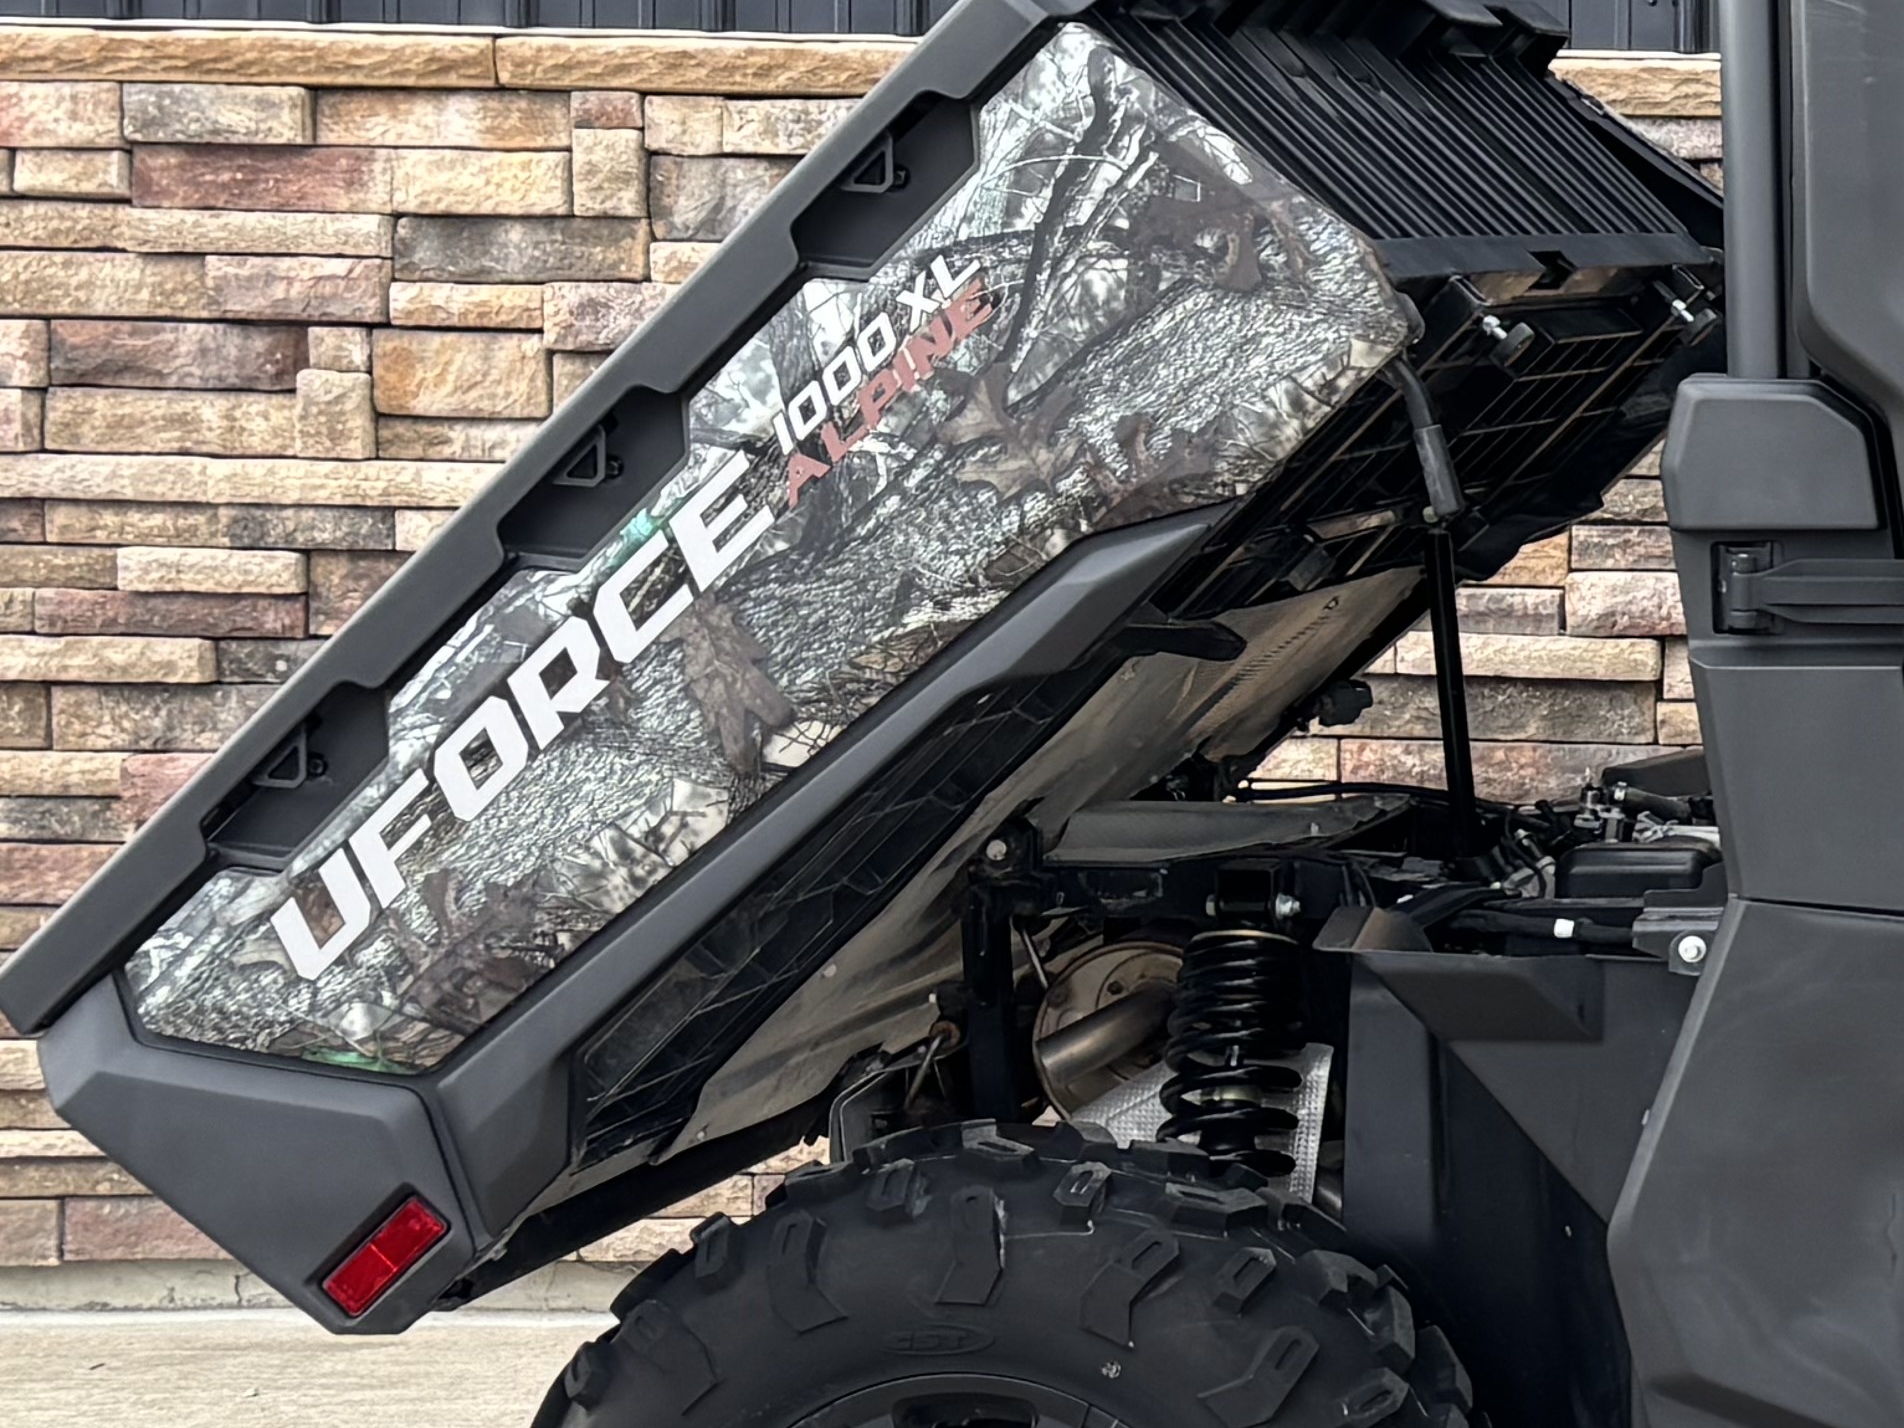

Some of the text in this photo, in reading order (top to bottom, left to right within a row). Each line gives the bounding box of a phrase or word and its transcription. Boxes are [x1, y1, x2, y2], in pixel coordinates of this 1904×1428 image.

[773, 255, 981, 455] 1000 XL
[788, 274, 993, 508] ALPINE
[271, 450, 774, 980] UFORCE
